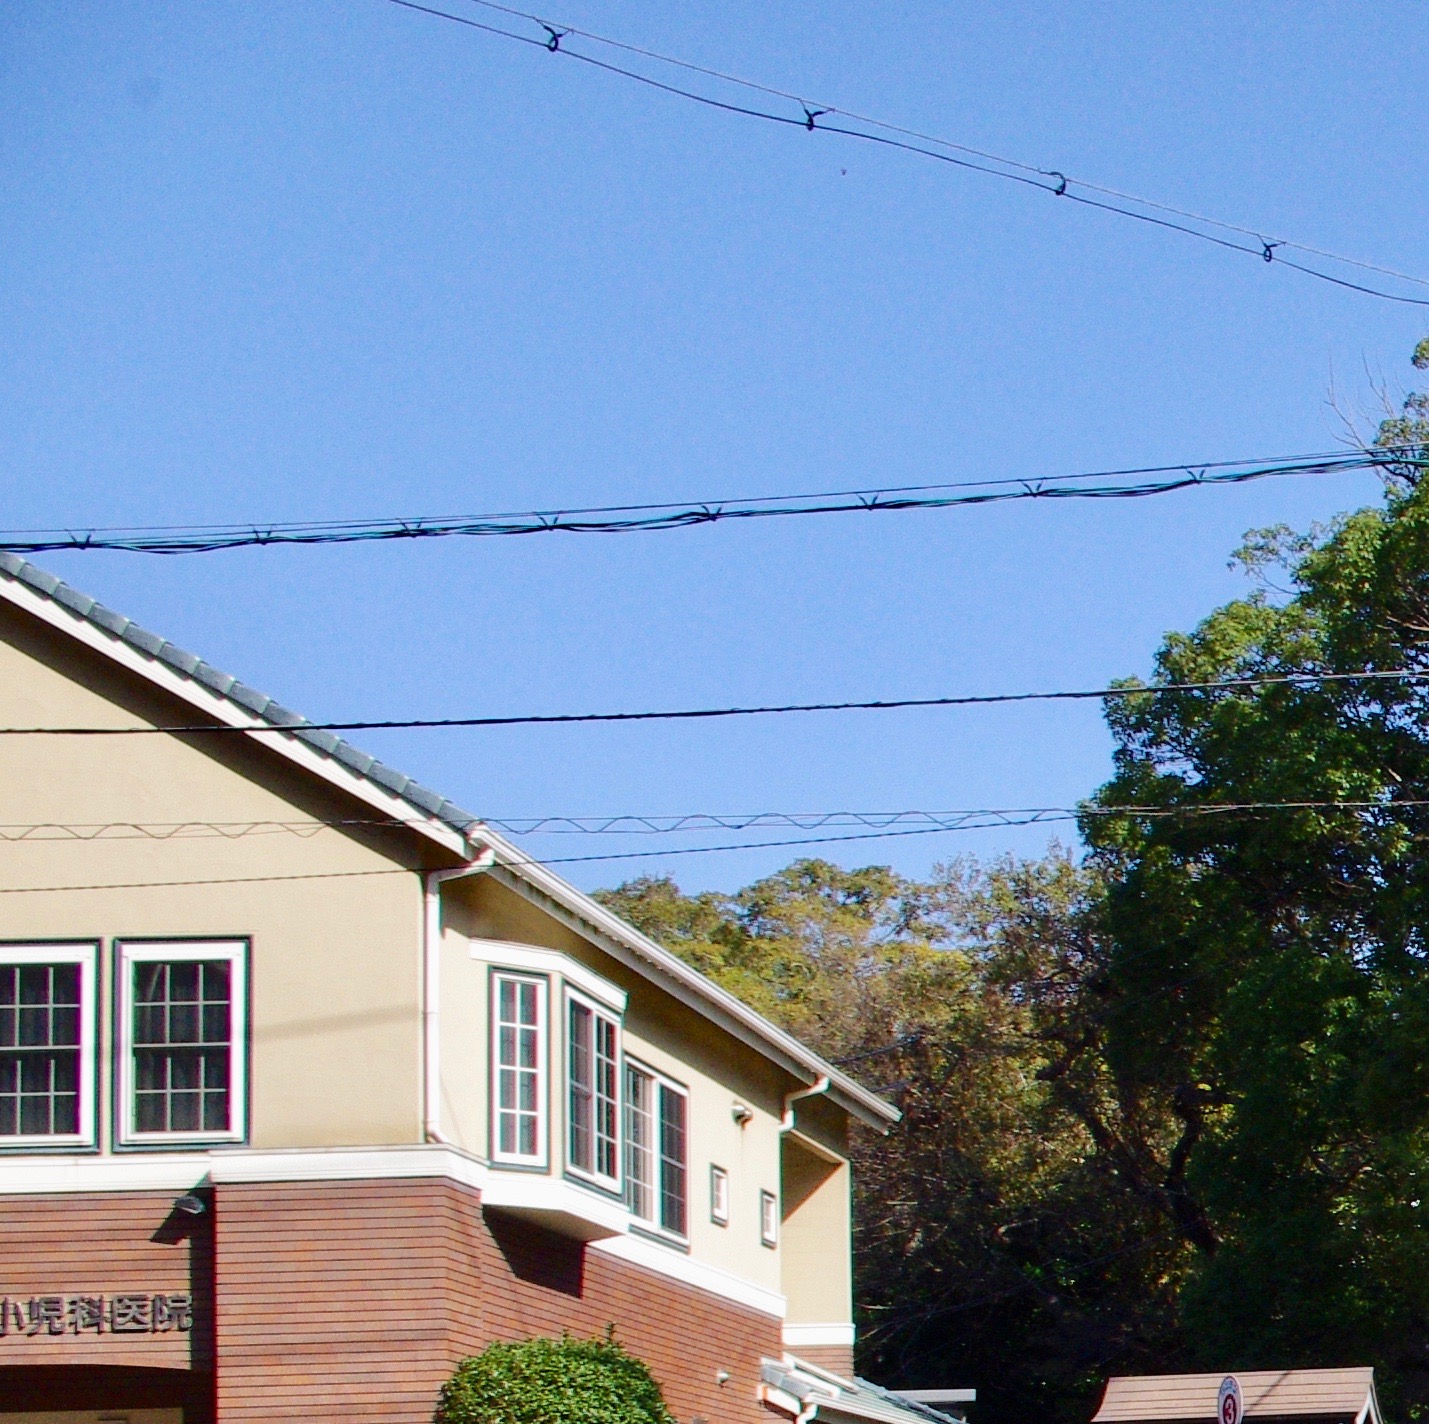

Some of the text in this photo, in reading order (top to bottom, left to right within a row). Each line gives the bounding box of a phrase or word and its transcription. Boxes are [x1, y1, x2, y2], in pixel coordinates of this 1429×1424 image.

[0, 1294, 192, 1335] 小児科医院
[1224, 1401, 1234, 1424] 3
